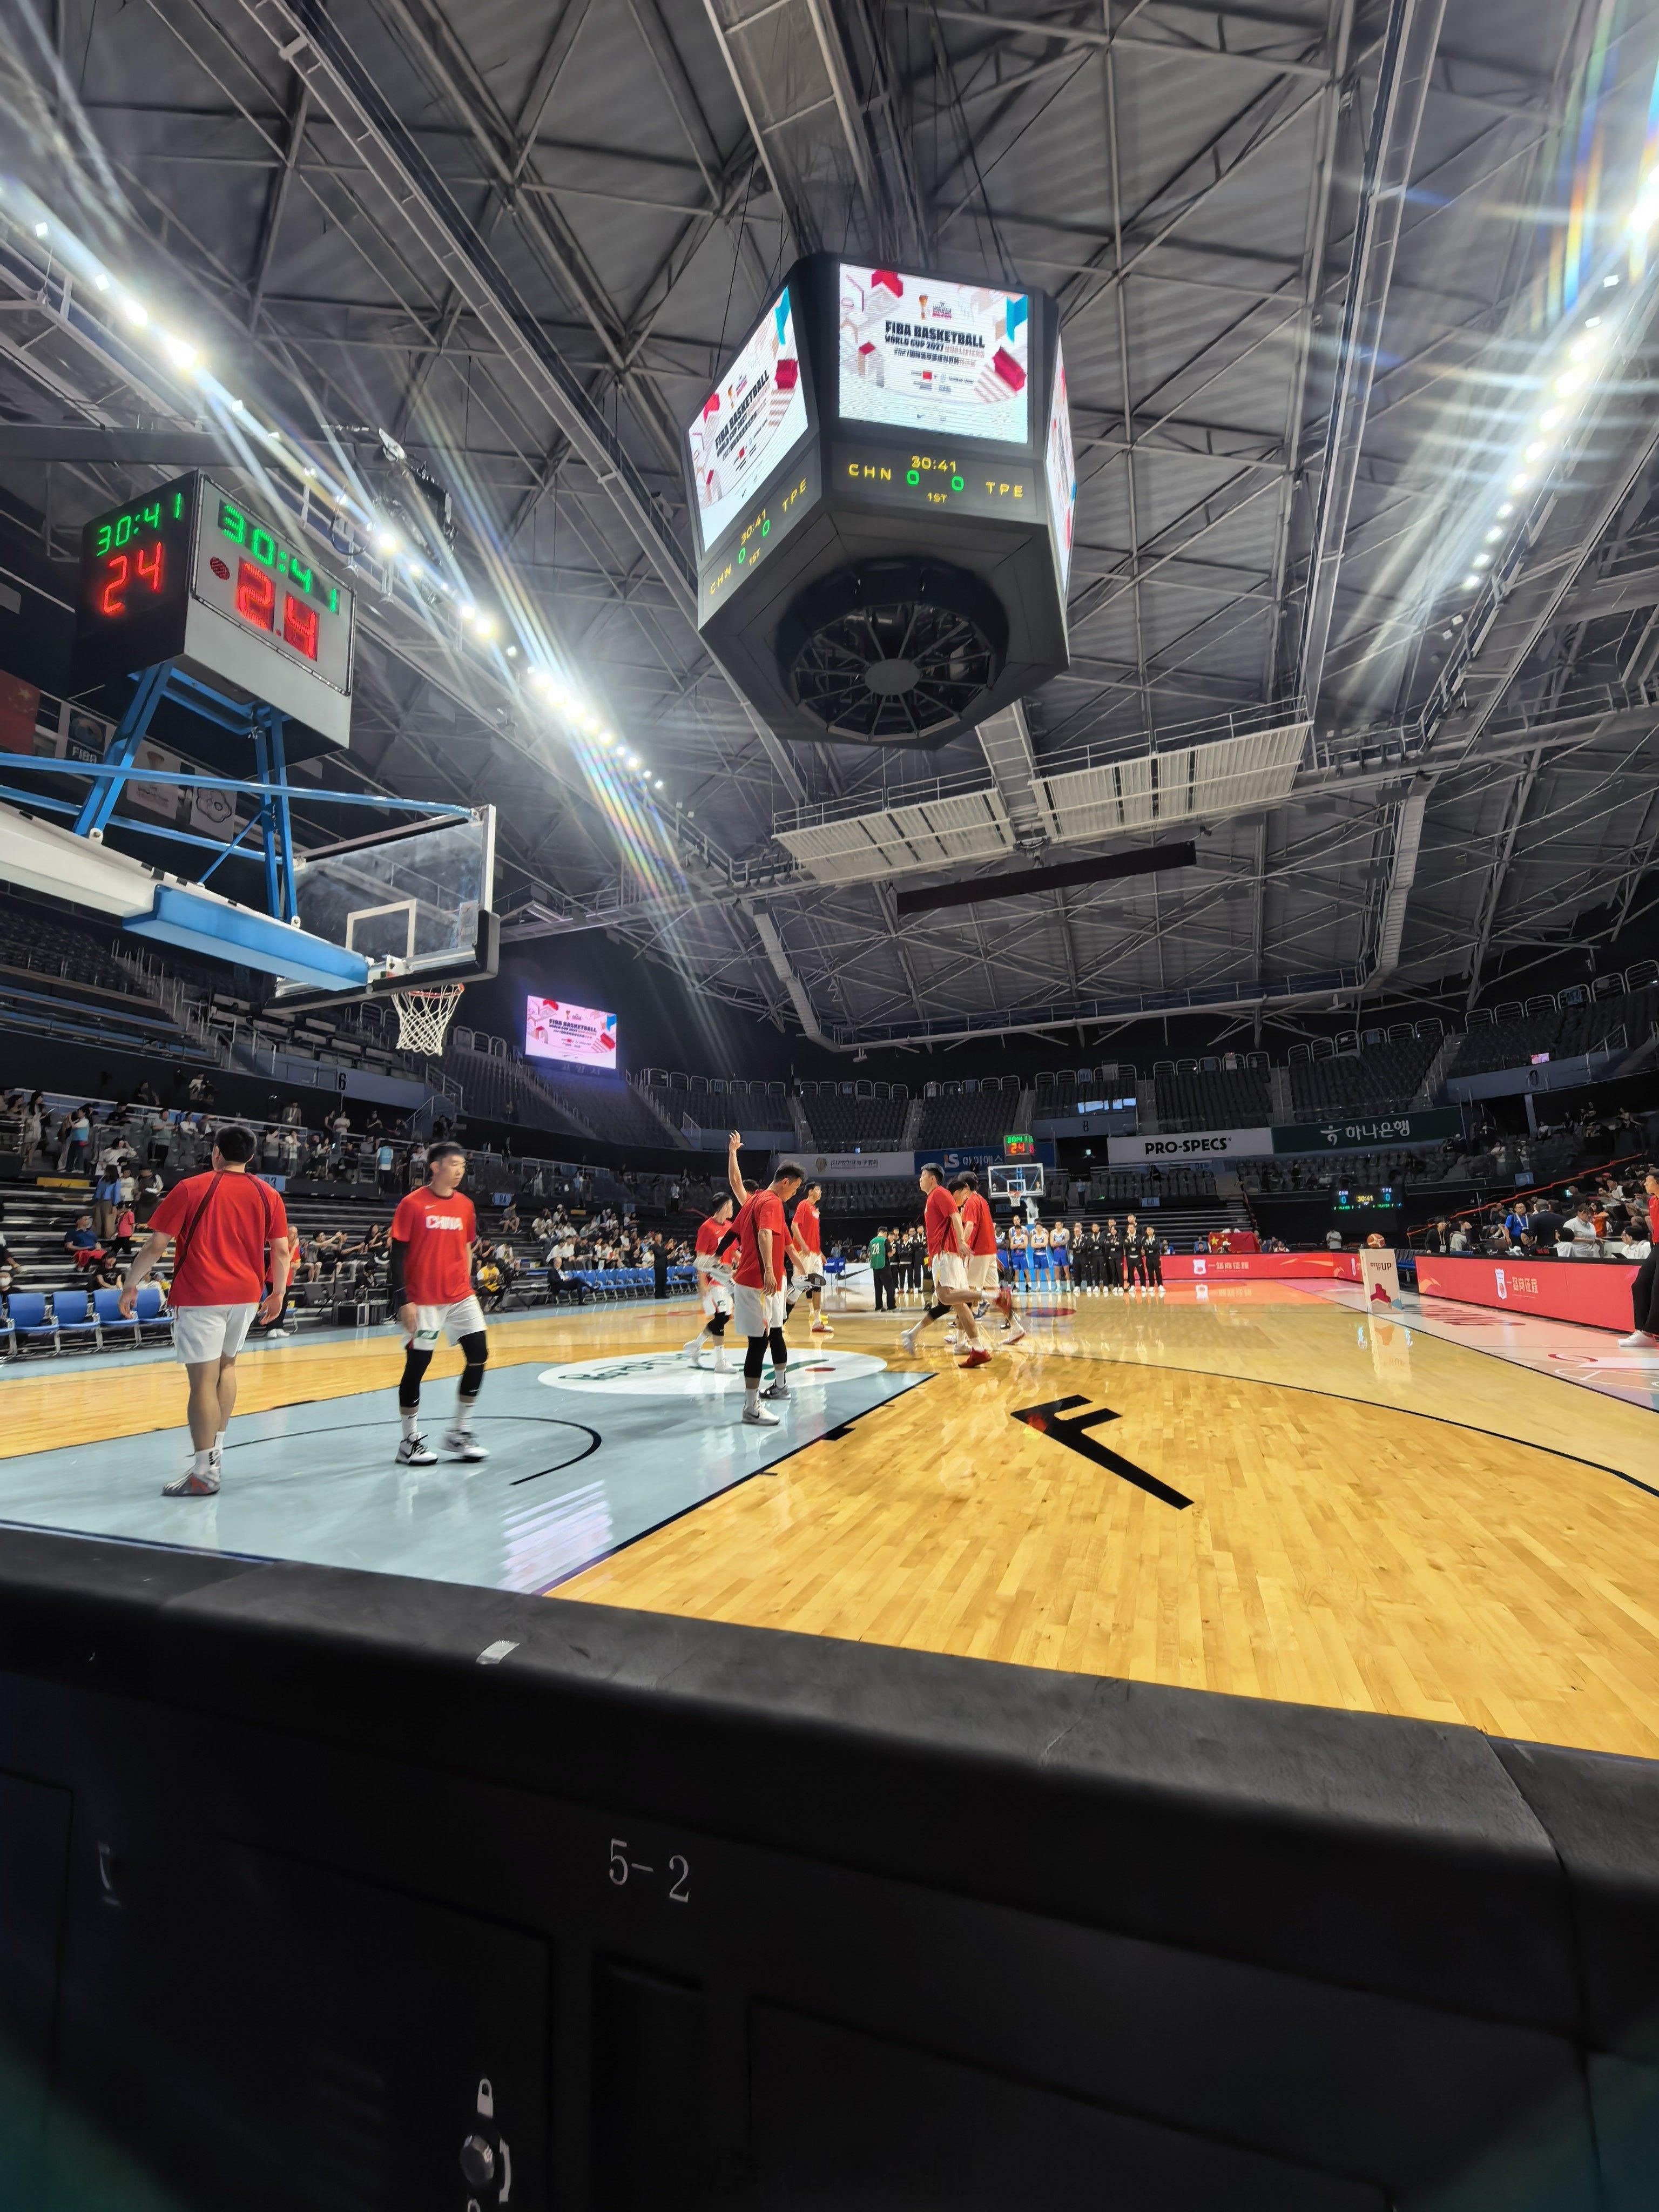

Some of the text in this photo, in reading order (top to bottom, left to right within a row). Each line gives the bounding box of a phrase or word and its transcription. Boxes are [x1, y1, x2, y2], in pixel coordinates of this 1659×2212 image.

[885, 320, 985, 348] FIBA BASKETBALL
[729, 370, 770, 430] BASKETBALL
[848, 463, 892, 481] CHN
[912, 456, 956, 473] 30:41
[907, 470, 920, 485] 0
[952, 476, 965, 491] 0
[782, 477, 807, 512] TPE
[986, 481, 1023, 498] TPE
[97, 492, 182, 556] 30:41
[221, 504, 338, 615] 30:41
[103, 541, 162, 613] 24
[710, 563, 731, 595] CHN
[238, 559, 318, 660] 24
[339, 1073, 346, 1090] 6
[1345, 1120, 1410, 1141] 하나은행
[1010, 1142, 1025, 1154] 24
[1145, 1137, 1228, 1155] PRO-SPECS
[872, 1243, 880, 1255] 28
[1381, 1262, 1392, 1271] UP
